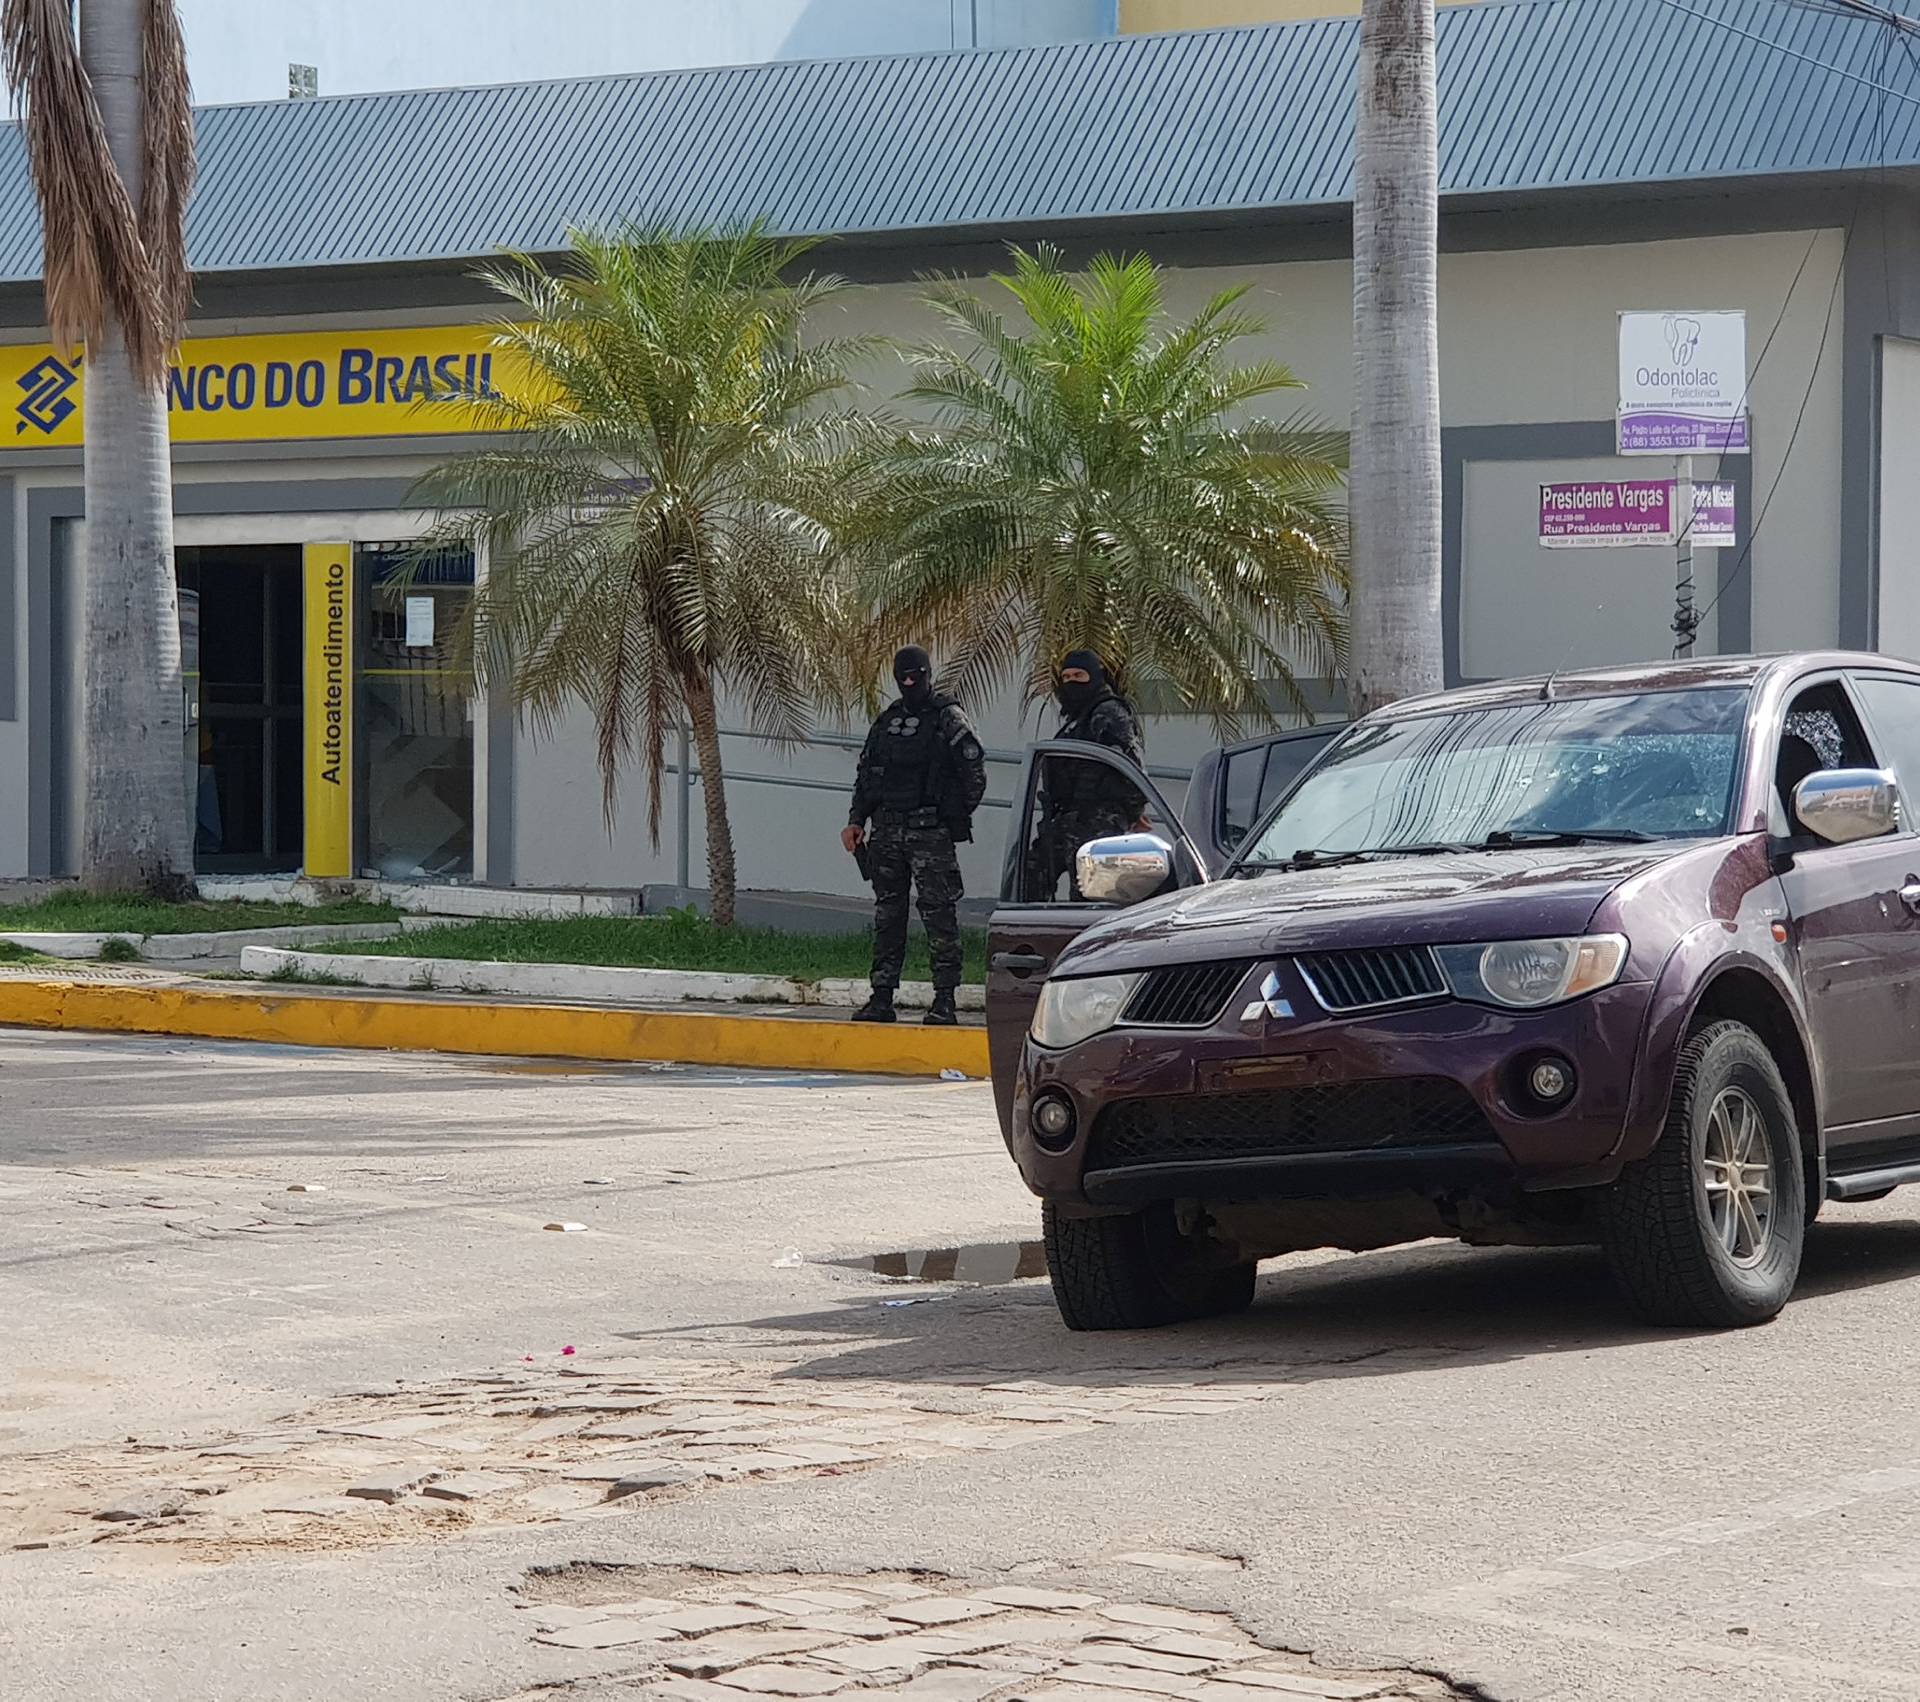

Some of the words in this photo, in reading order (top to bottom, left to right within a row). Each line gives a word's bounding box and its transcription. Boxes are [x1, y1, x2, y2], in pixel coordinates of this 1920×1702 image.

[167, 363, 256, 411] NCO
[264, 359, 325, 408] DO
[338, 348, 500, 405] BRASIL
[1636, 367, 1718, 386] Odontolac
[1542, 485, 1614, 510] Presidente
[1617, 484, 1664, 513] Vargas
[1543, 524, 1564, 534] Rua
[1566, 522, 1622, 533] Presidente
[1624, 521, 1660, 534] Vargas
[321, 563, 344, 785] Autoatendimento
